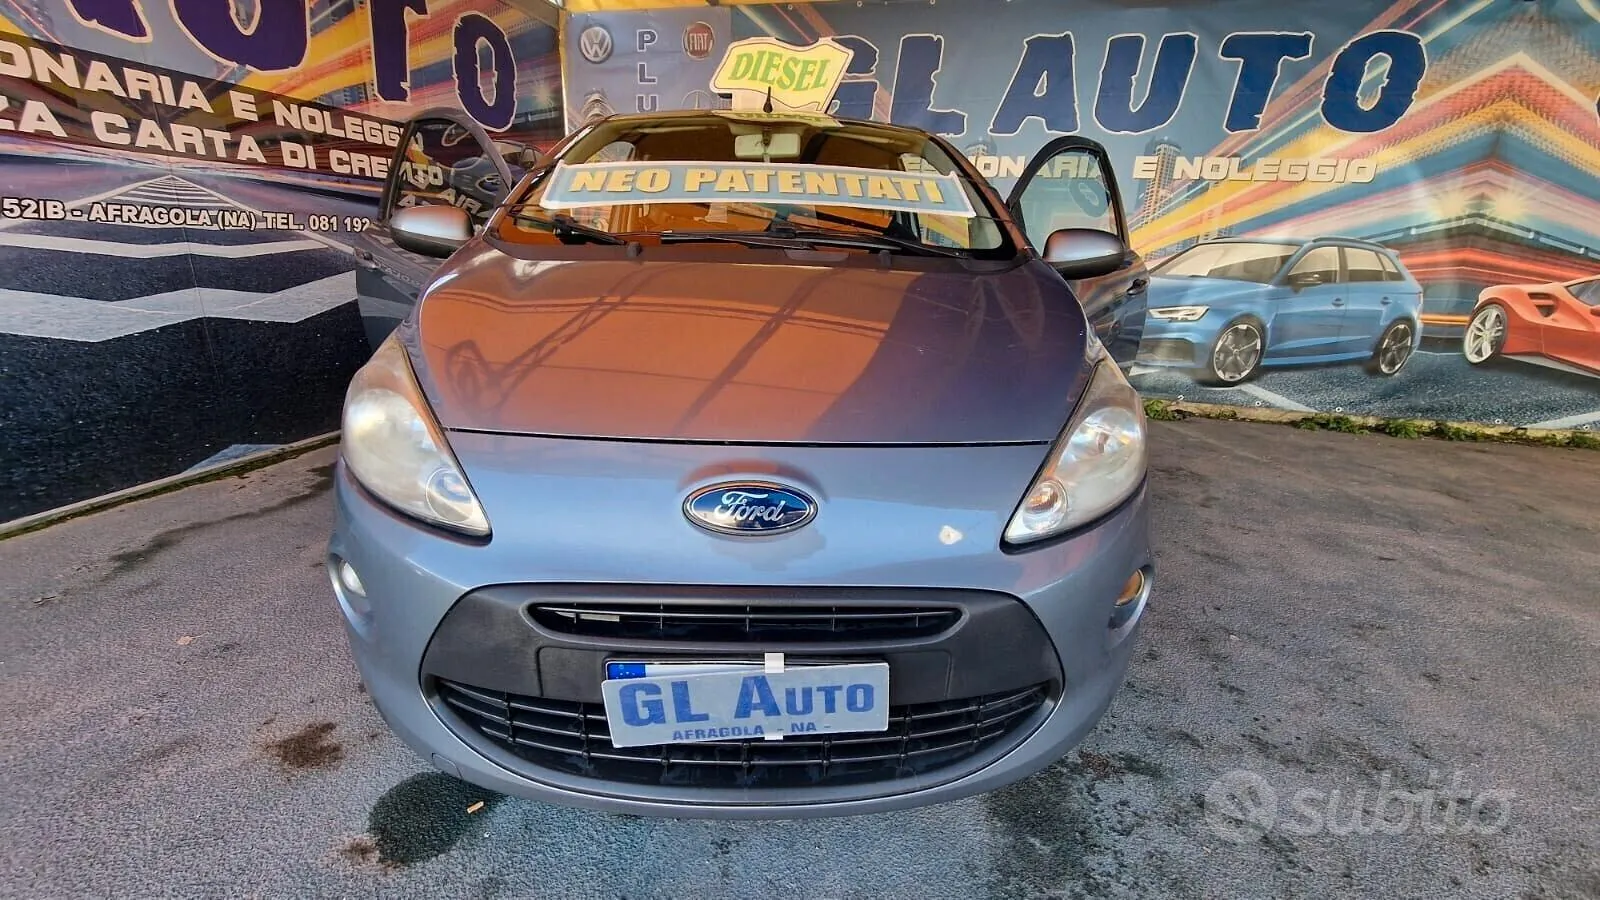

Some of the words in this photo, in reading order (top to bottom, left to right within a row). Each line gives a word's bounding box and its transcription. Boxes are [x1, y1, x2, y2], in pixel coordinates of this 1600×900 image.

[728, 50, 831, 93] DIESEL
[229, 90, 259, 122] E
[90, 110, 267, 164] CARTA
[280, 140, 317, 170] DI
[568, 168, 671, 193] NEO
[684, 167, 945, 204] PATENTATI
[1133, 156, 1158, 179] E
[1172, 156, 1378, 184] NOLEGGIO
[88, 201, 212, 227] AFRAGOLA
[217, 210, 257, 231] (NA)
[262, 212, 304, 231] TEL.
[308, 213, 339, 232] 081
[712, 490, 786, 523] Ford
[618, 680, 710, 727] GL
[672, 724, 765, 741] AFRAGOLA
[790, 721, 817, 733] NA
